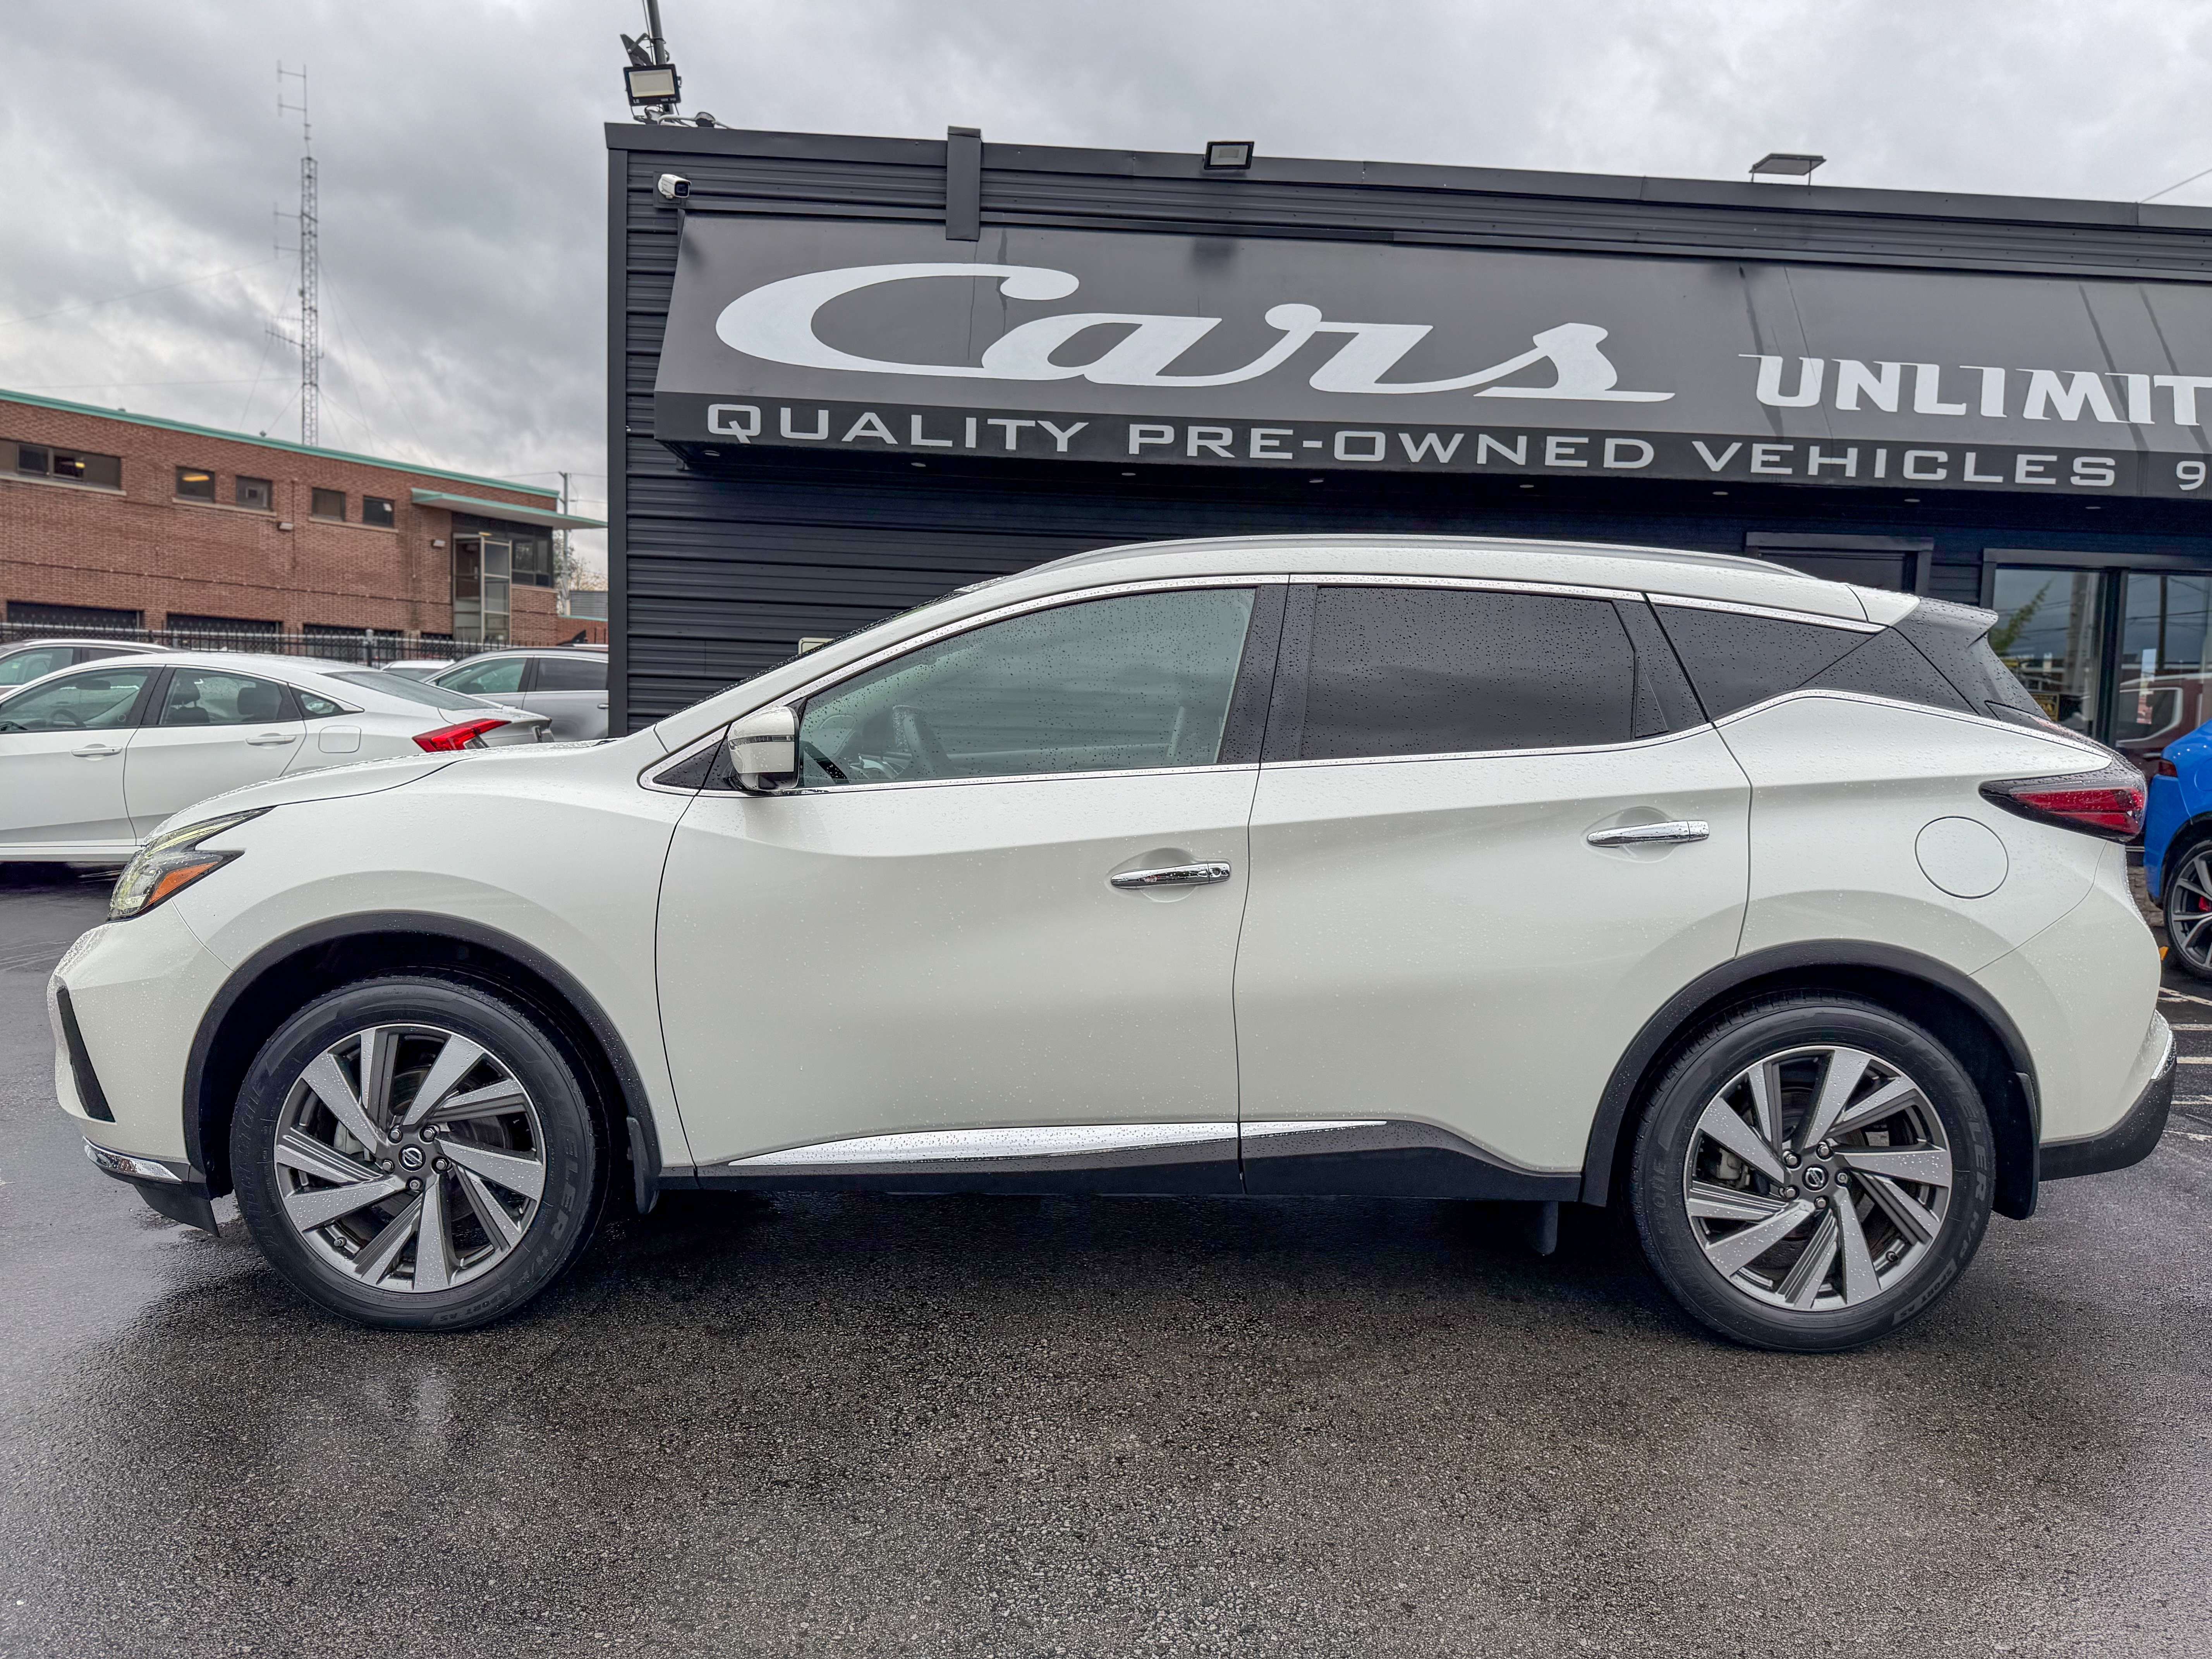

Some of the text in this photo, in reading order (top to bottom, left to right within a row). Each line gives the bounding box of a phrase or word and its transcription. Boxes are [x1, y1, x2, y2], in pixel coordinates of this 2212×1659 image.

[716, 263, 1675, 402] Cars
[708, 404, 2205, 490] QUALITY PRE-OWNED VEHICLES 9
